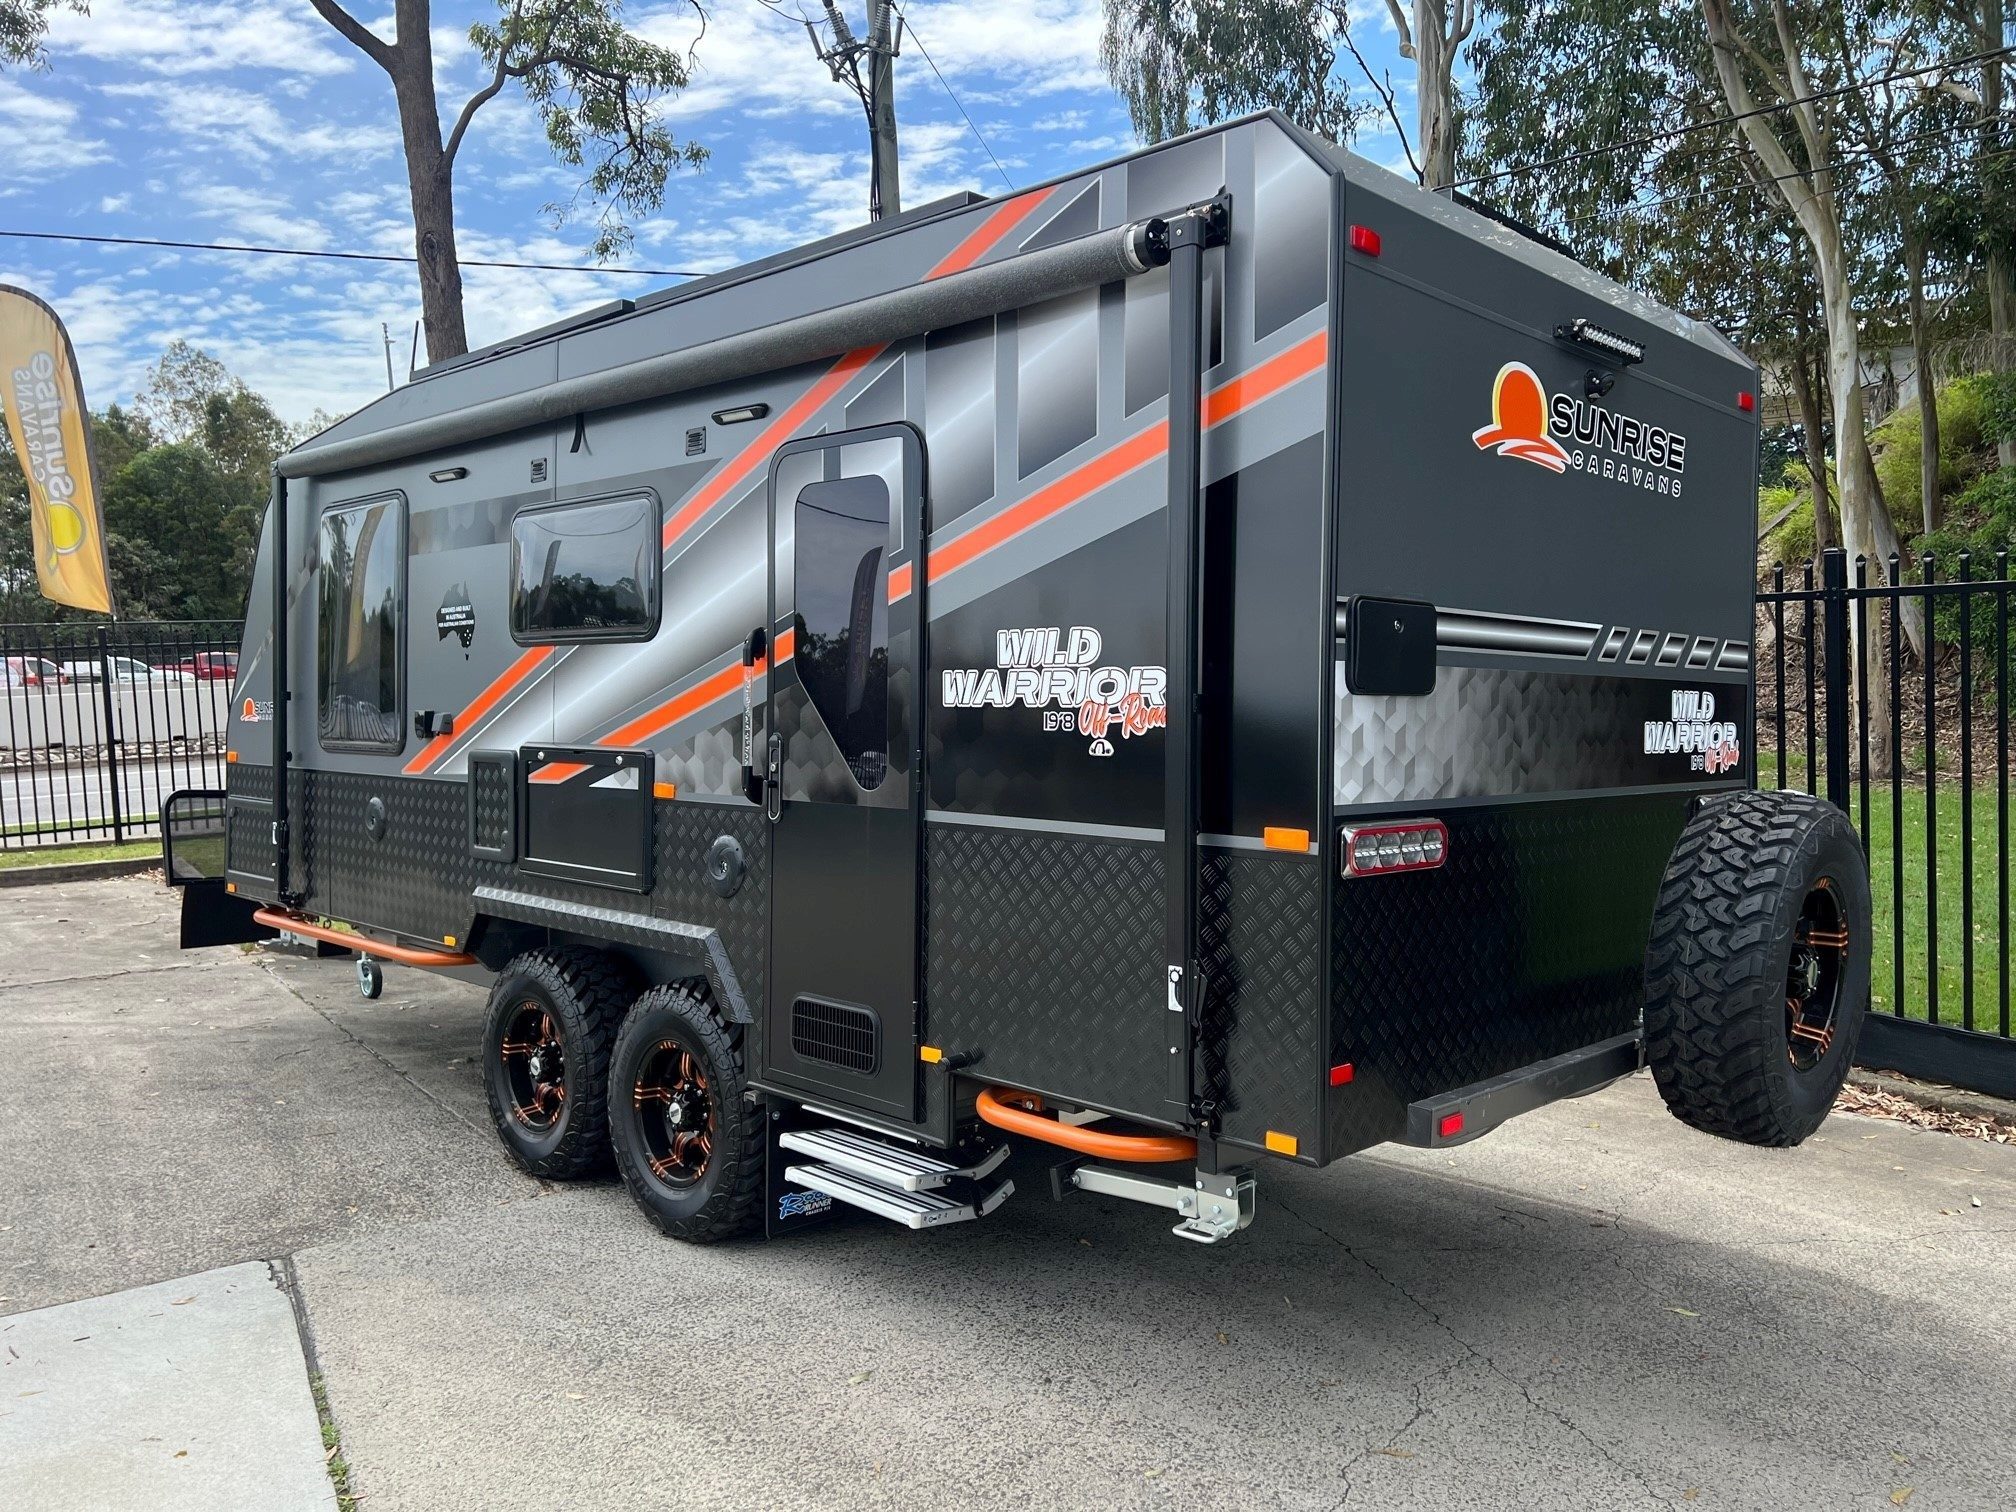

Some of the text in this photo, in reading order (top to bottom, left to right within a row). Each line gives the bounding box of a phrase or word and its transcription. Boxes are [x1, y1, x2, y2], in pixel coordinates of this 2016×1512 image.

[1550, 393, 1686, 473] SUNRISE
[1572, 450, 1682, 498] CARAVANS
[997, 626, 1102, 668] WILD
[942, 666, 1166, 707] WARRIOR
[1672, 690, 1715, 721] WILD
[1644, 722, 1737, 754] WARRIOR
